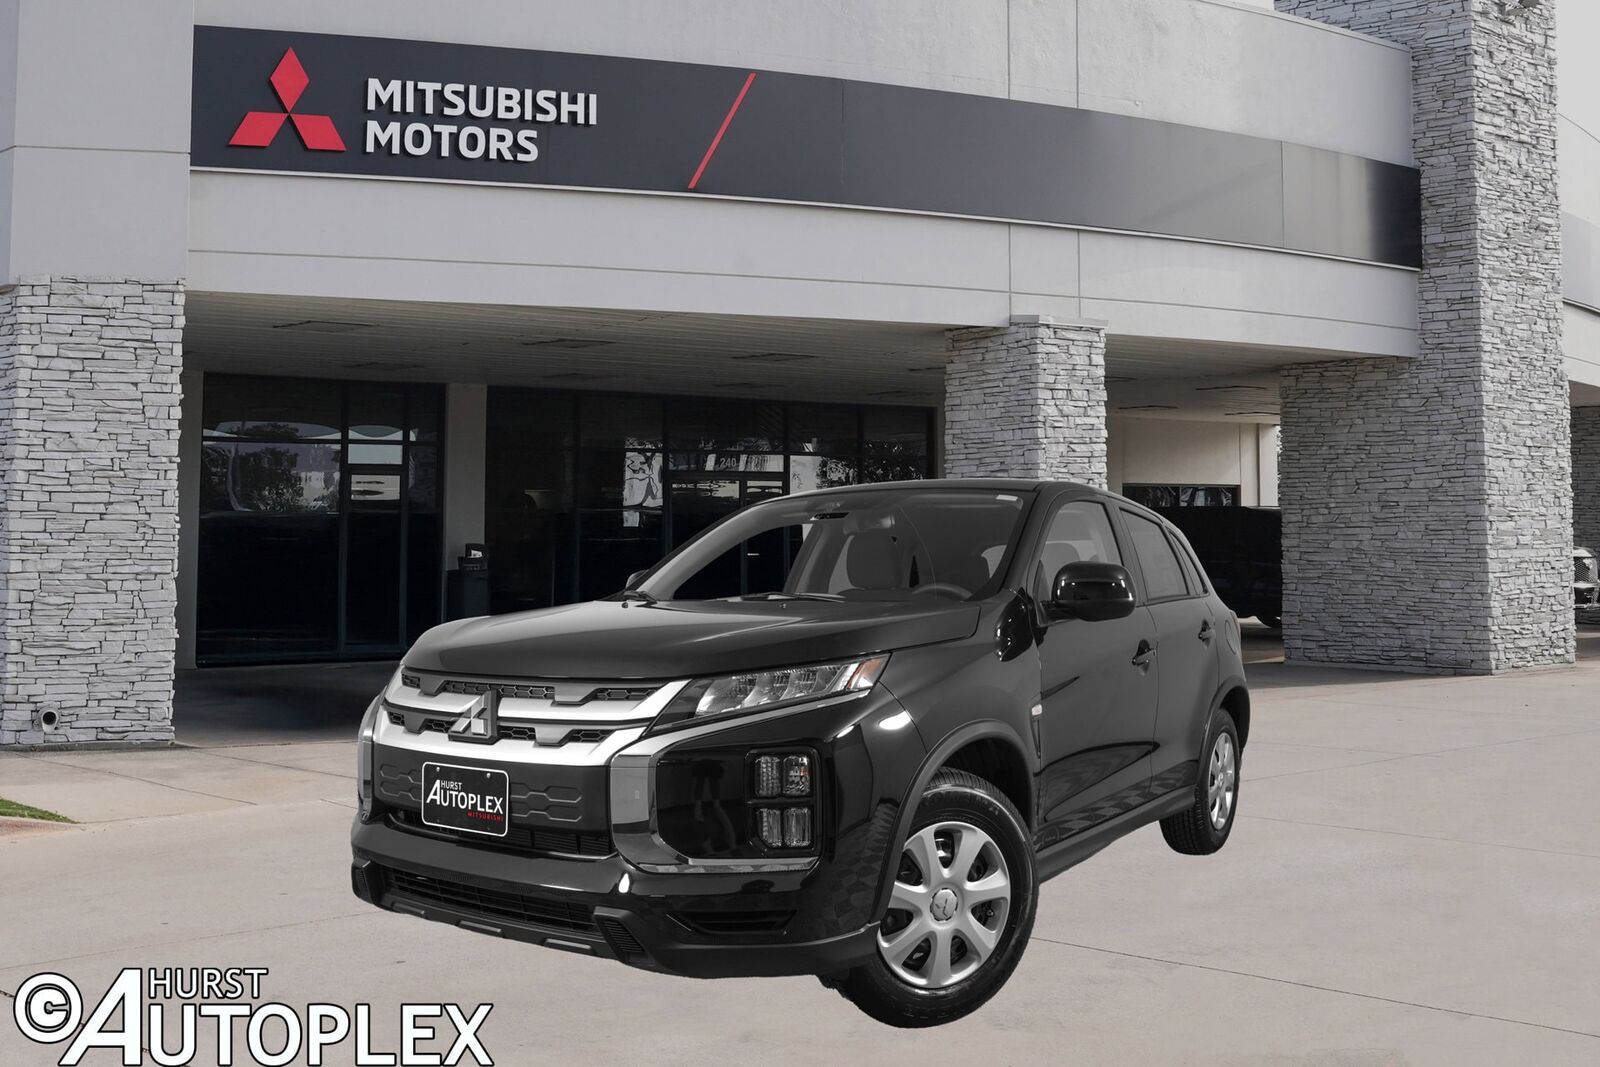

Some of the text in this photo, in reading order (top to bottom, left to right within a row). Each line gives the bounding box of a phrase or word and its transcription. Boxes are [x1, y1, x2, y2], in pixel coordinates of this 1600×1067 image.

[366, 78, 597, 125] MITSUBISHI
[365, 120, 539, 162] MOTORS
[720, 458, 736, 468] 240
[426, 779, 503, 814] AUTOPLEX
[440, 780, 463, 791] HURST
[467, 811, 504, 822] MITSUBISHI
